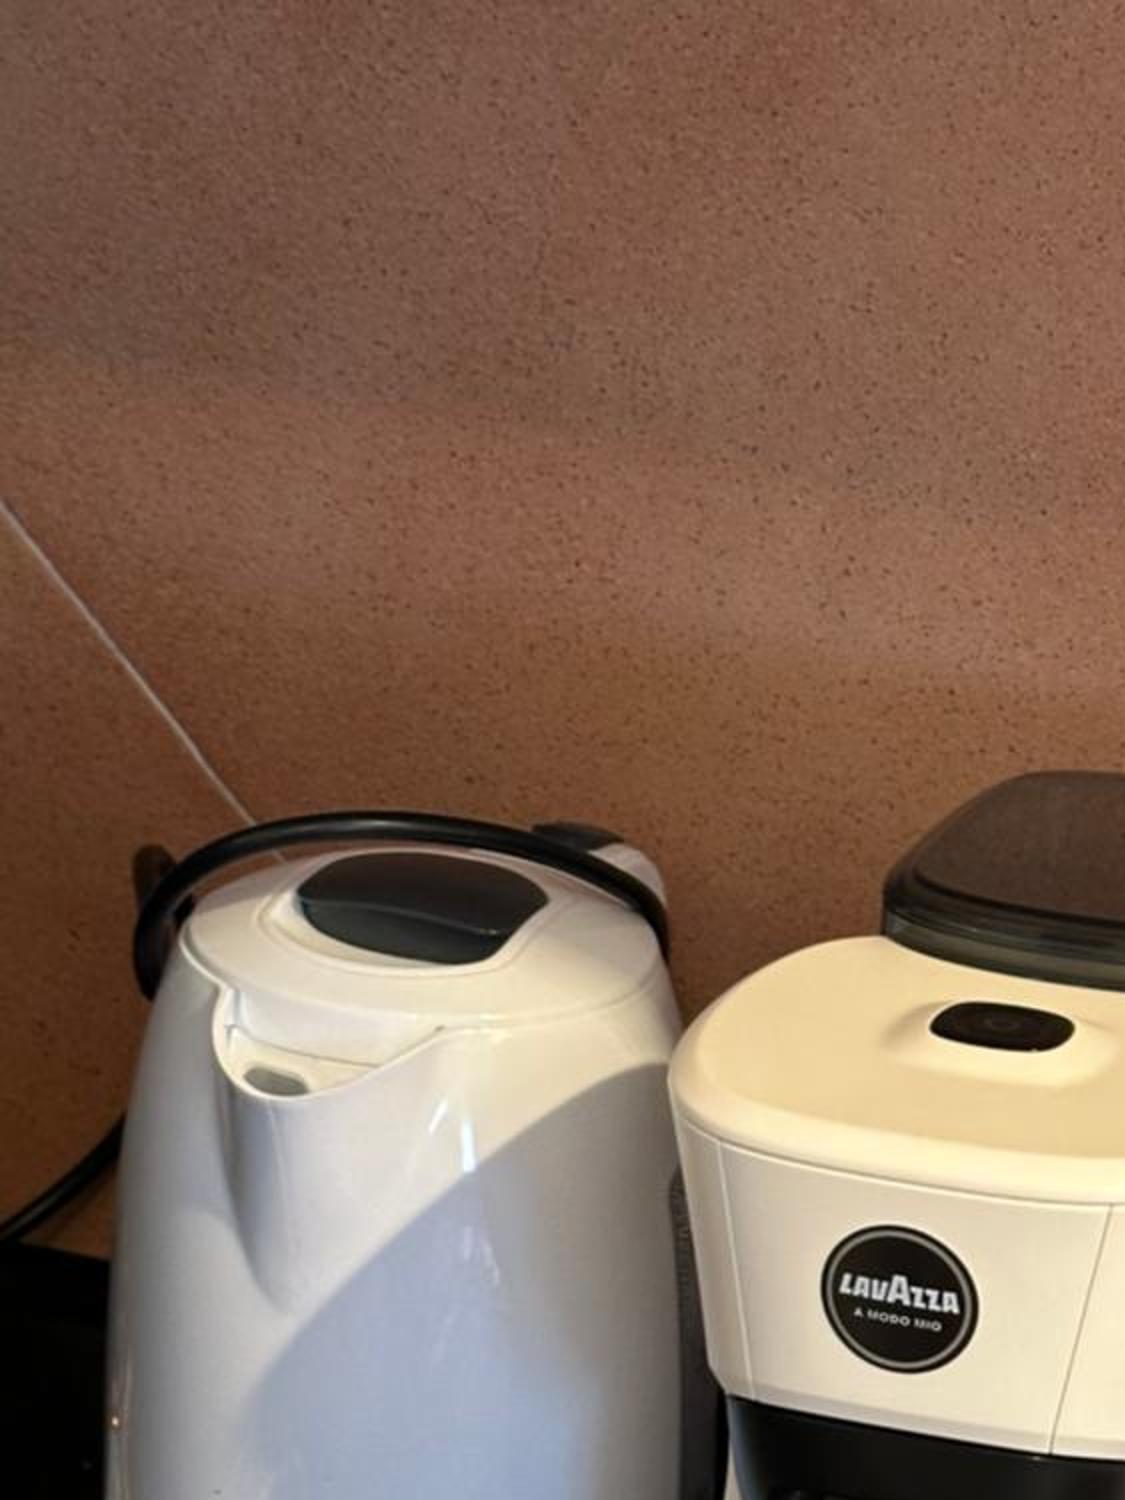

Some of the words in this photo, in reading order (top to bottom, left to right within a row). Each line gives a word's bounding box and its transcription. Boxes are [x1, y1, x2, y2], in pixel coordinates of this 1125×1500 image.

[839, 1273, 960, 1315] LAVAZZA
[854, 1307, 864, 1318] A
[867, 1309, 911, 1327] MODO
[914, 1318, 942, 1332] MIO
